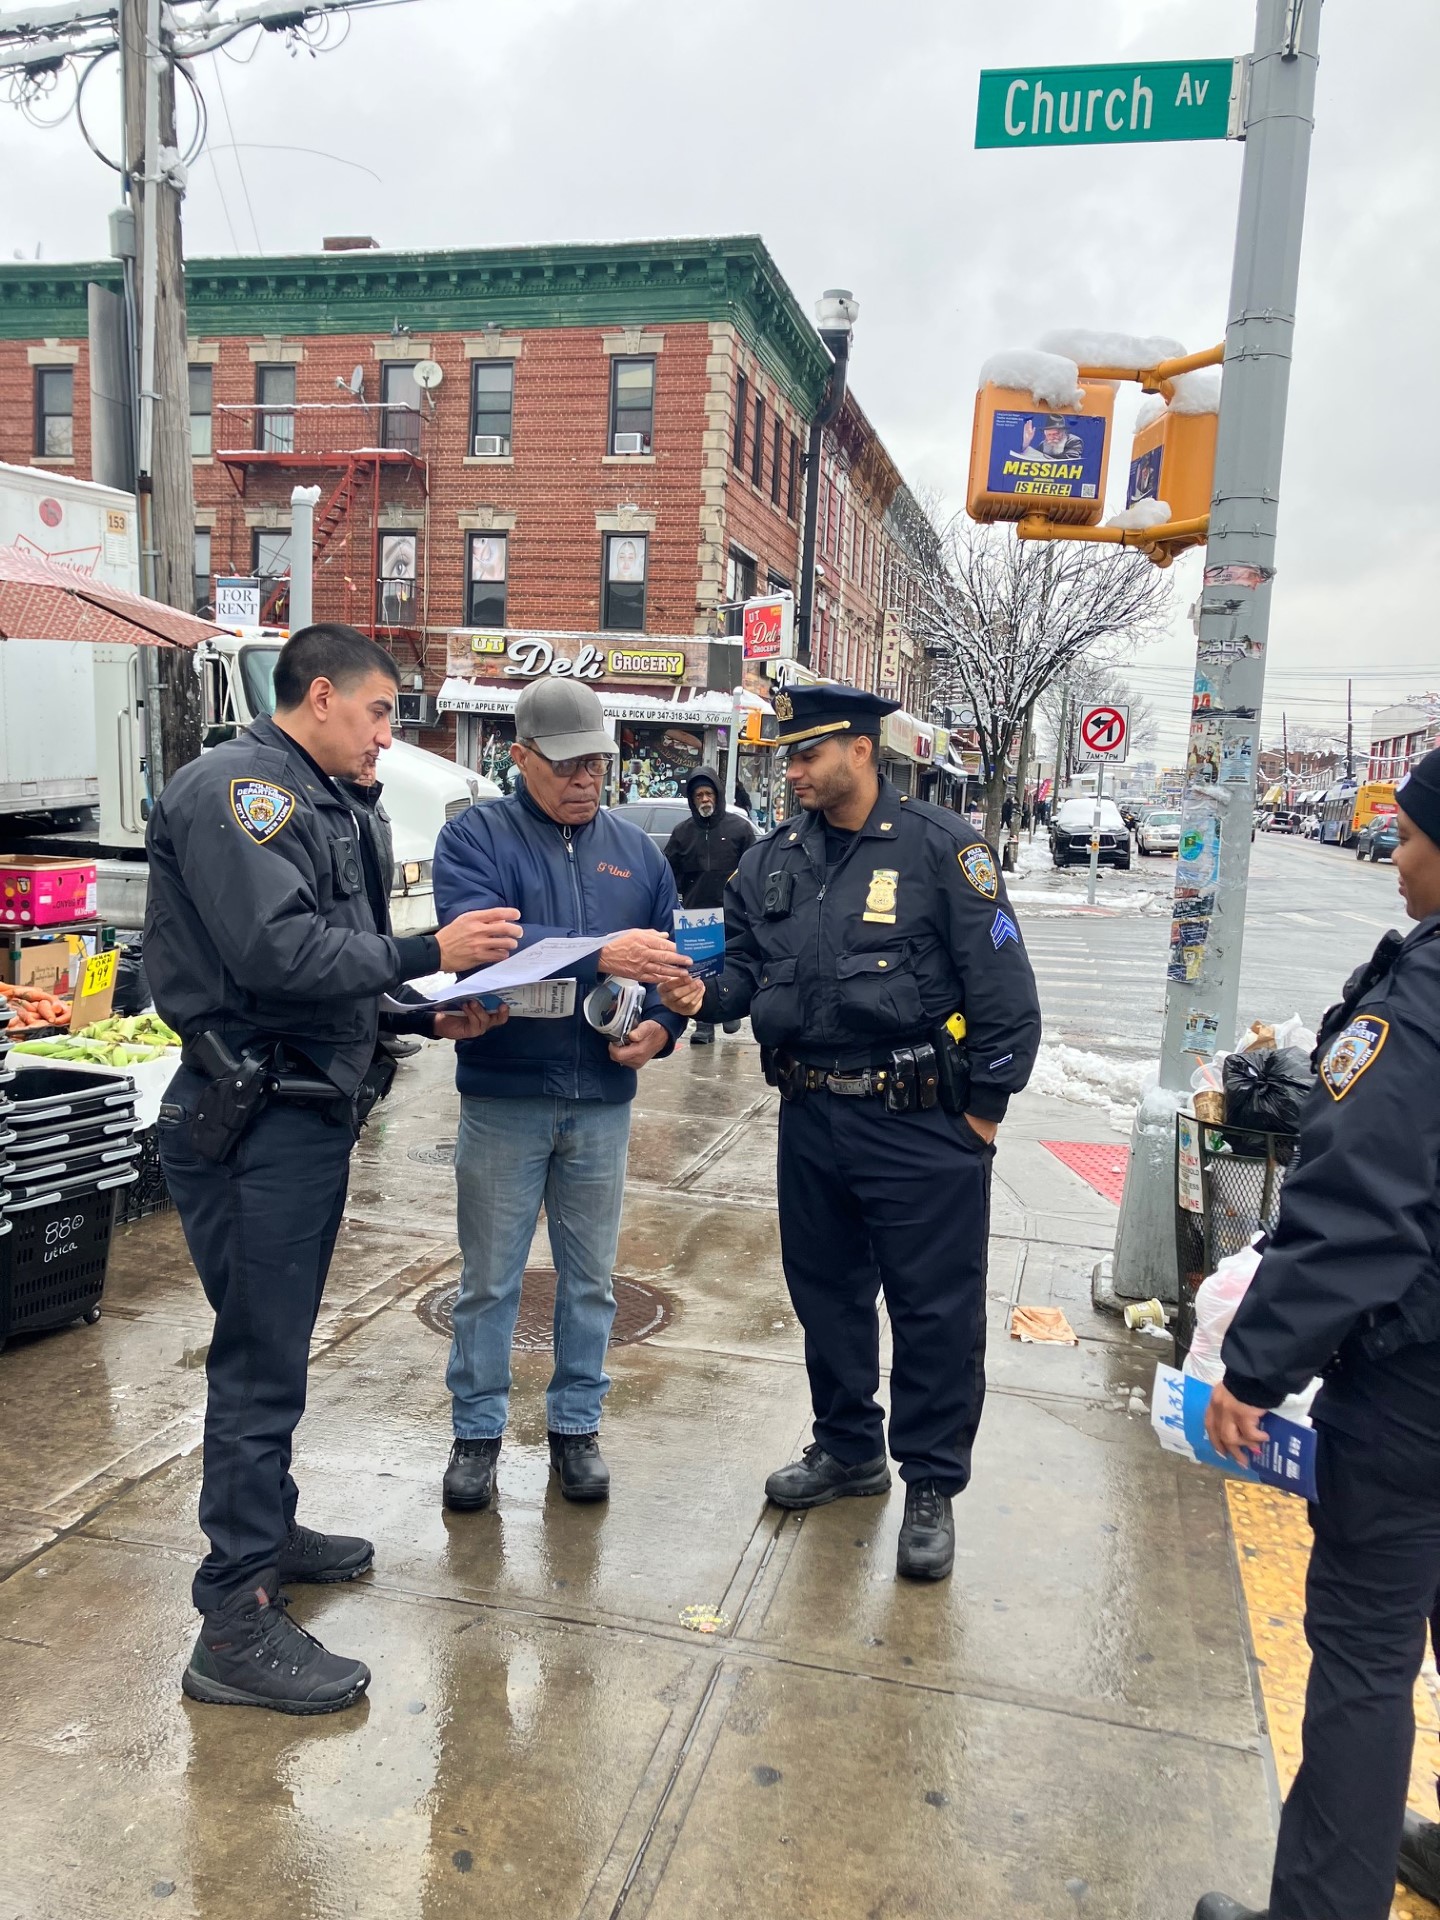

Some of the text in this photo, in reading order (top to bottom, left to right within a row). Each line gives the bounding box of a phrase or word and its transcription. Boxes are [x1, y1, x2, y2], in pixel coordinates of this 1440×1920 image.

[1004, 71, 1210, 137] Church Av
[1003, 461, 1084, 479] MESSIAH
[1016, 482, 1070, 496] IS HERE!
[108, 515, 125, 530] 153
[222, 589, 252, 602] FOR
[218, 603, 258, 615] RENT
[749, 610, 760, 623] UT
[750, 621, 778, 645] Deli
[473, 637, 680, 679] UT Deli GROCERY
[456, 701, 470, 709] ATM
[475, 702, 495, 711] APPLE
[497, 703, 509, 711] PAY
[604, 709, 700, 721] CALL & PICK UP 347-318-3443
[705, 713, 720, 723] 876
[237, 788, 289, 802] DEPARTMENT
[249, 783, 278, 793] POLICE
[236, 803, 253, 830] CITY OF
[264, 804, 290, 835] NEW YORK
[597, 861, 632, 878] G Unit
[1353, 1048, 1374, 1069] YORK
